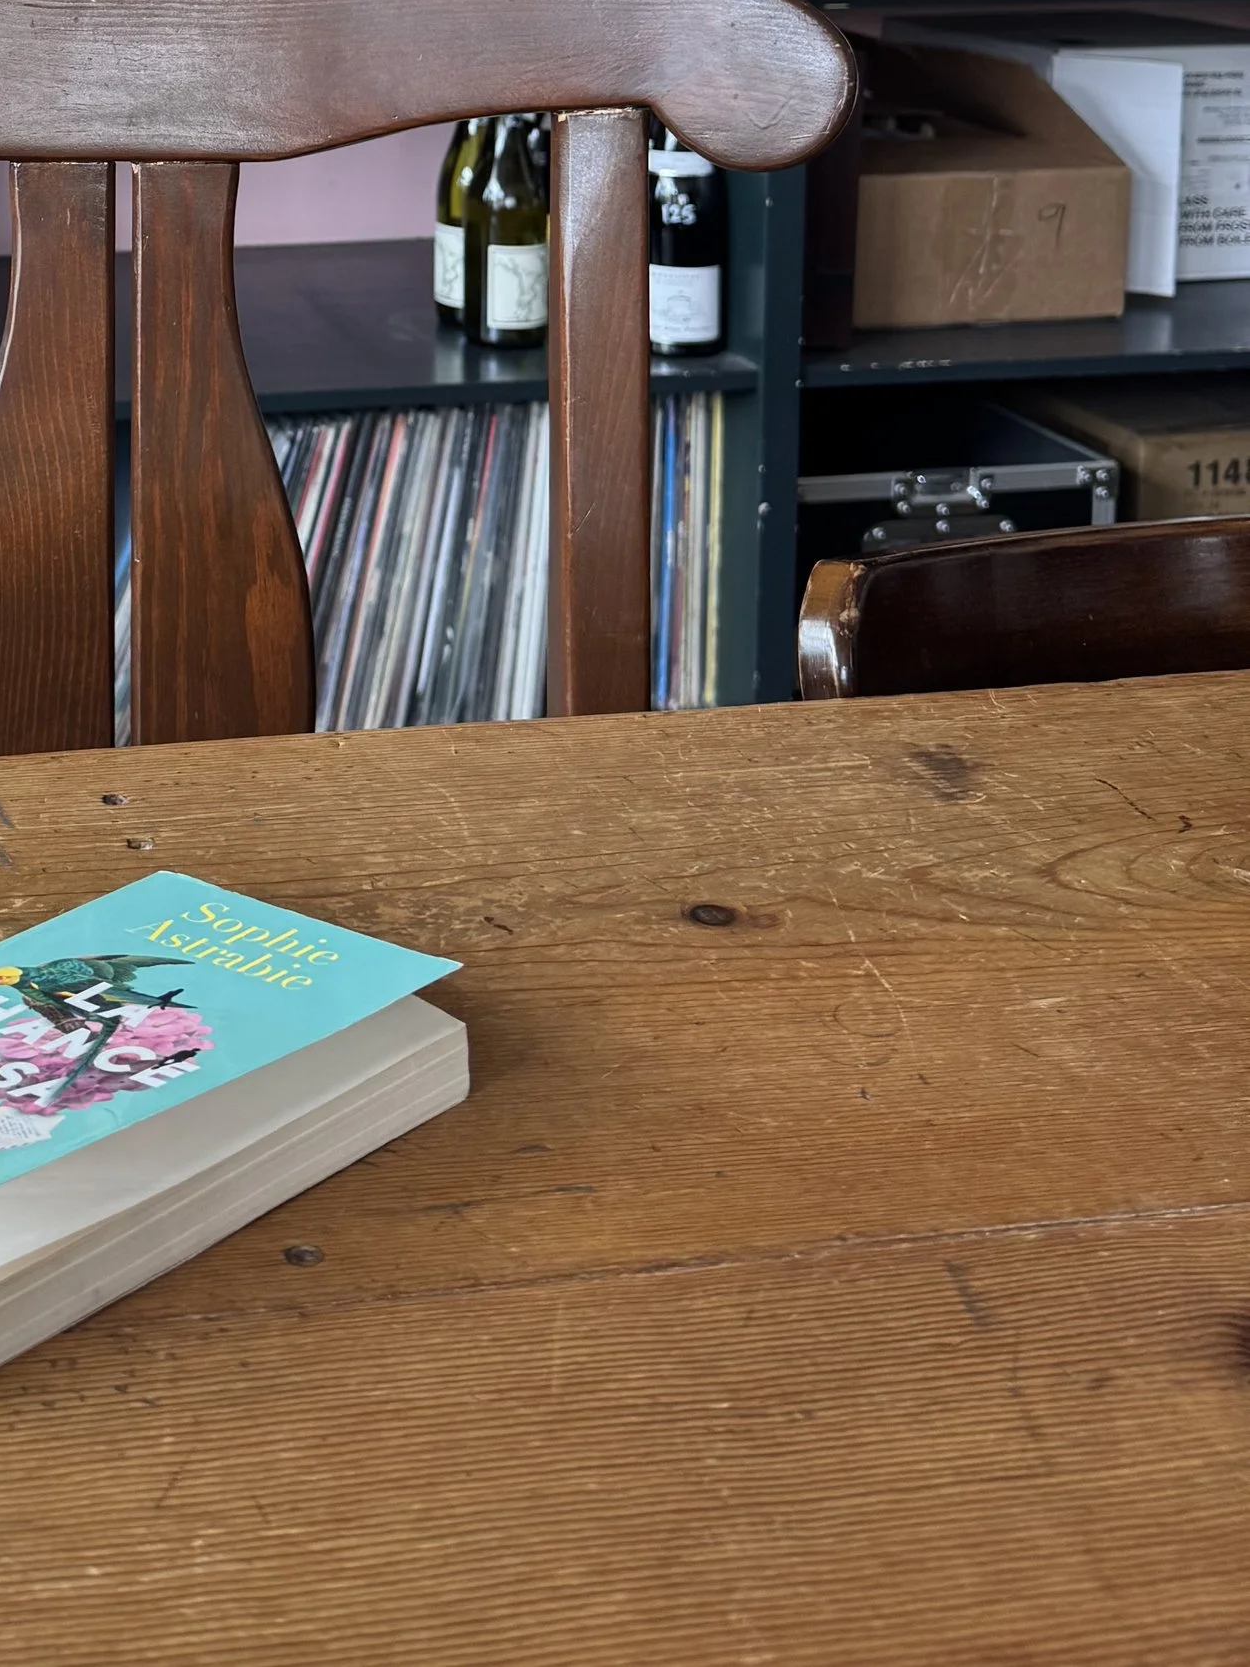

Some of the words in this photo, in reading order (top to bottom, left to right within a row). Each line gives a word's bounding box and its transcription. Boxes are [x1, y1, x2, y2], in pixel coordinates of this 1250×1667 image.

[1178, 221, 1212, 232] FROM
[1212, 206, 1246, 218] CARE
[1178, 235, 1214, 247] FROM
[180, 902, 339, 966] Sophie
[124, 919, 313, 990] Astrabie
[64, 981, 155, 1028] LA
